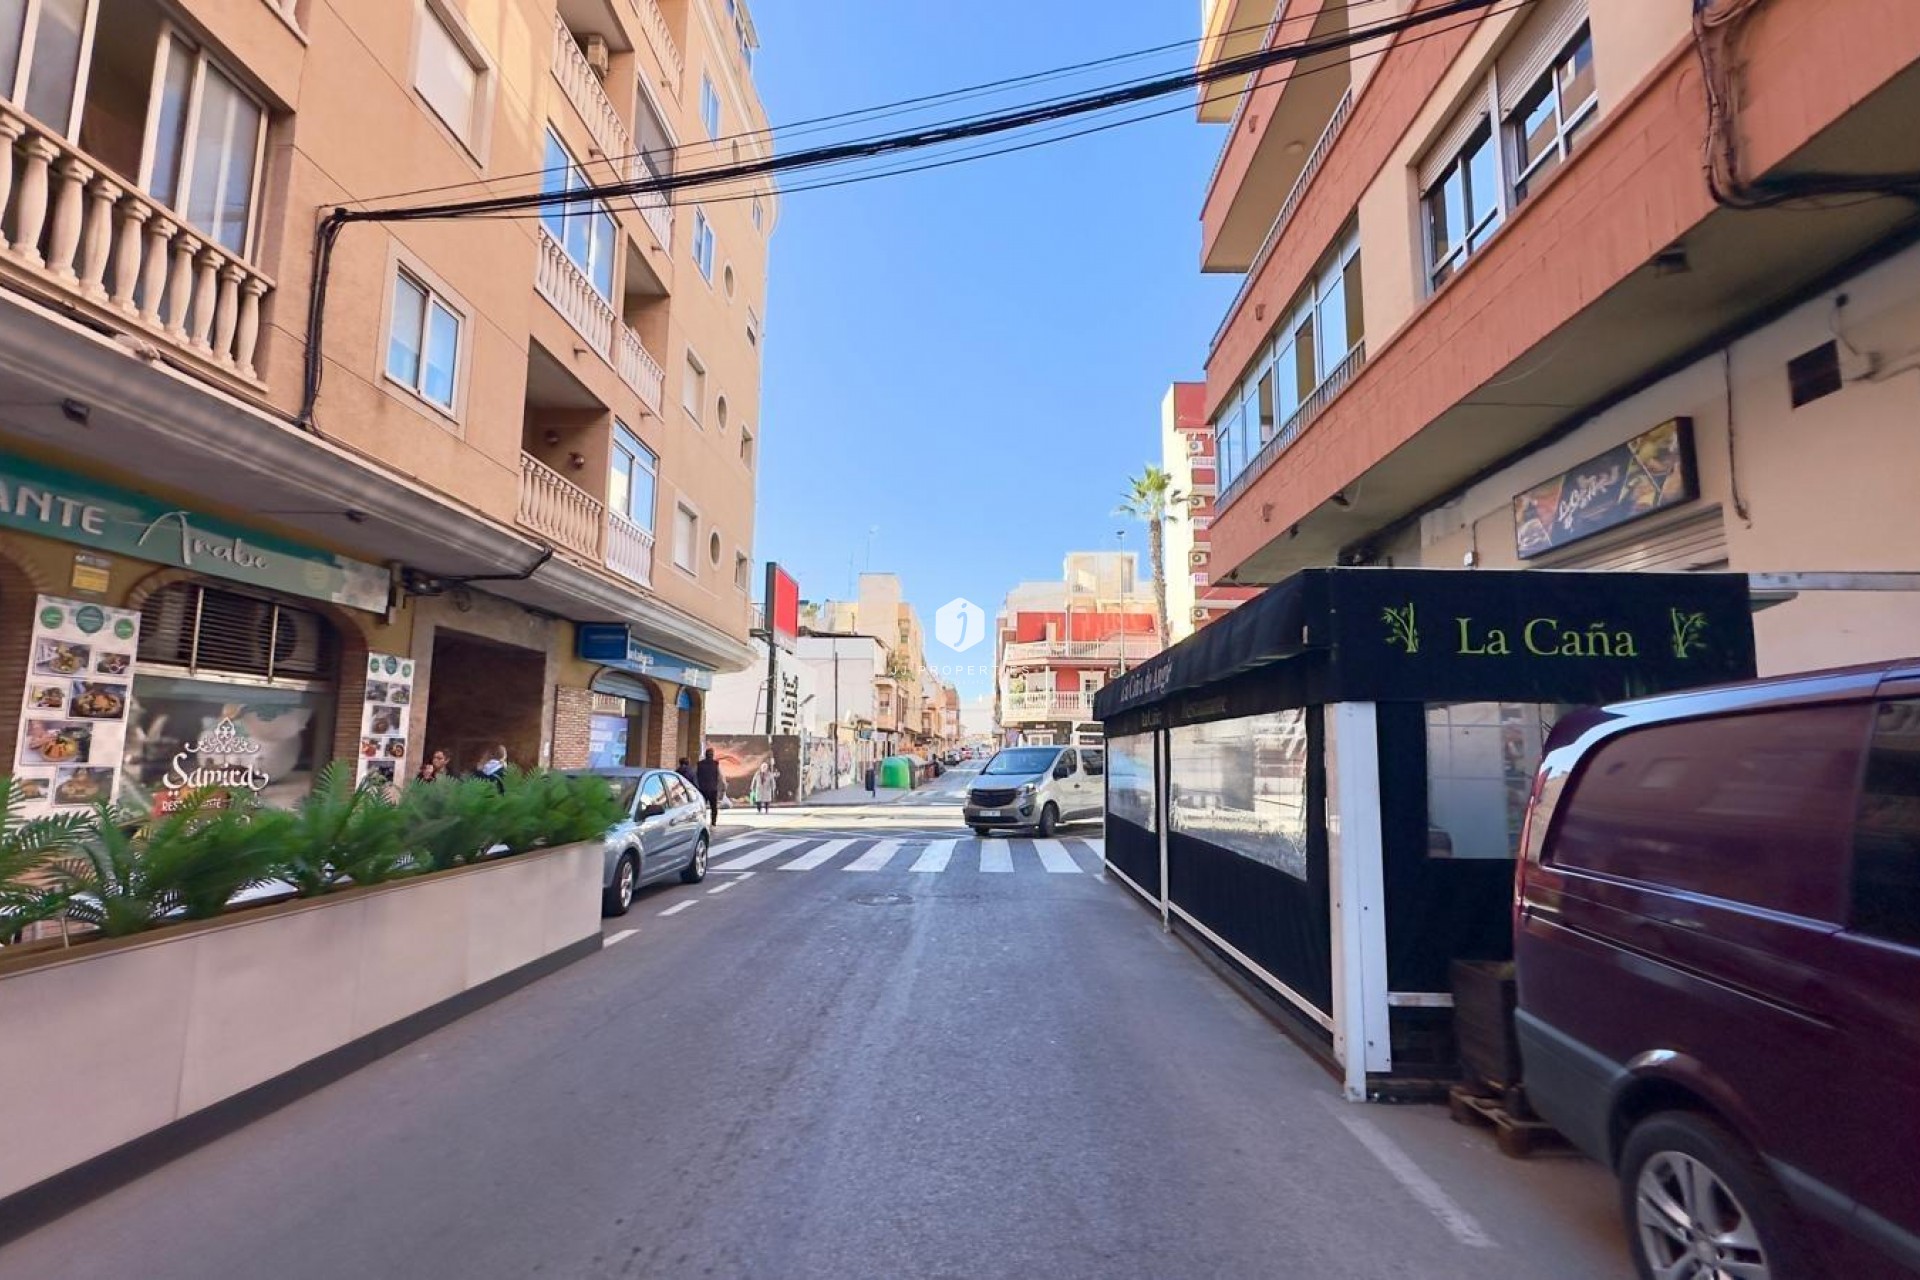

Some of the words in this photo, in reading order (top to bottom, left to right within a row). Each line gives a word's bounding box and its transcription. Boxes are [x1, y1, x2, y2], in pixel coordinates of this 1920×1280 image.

[137, 511, 269, 567] Arabe
[1455, 617, 1512, 655] La
[1523, 617, 1638, 657] Caña
[162, 752, 269, 791] Samira
